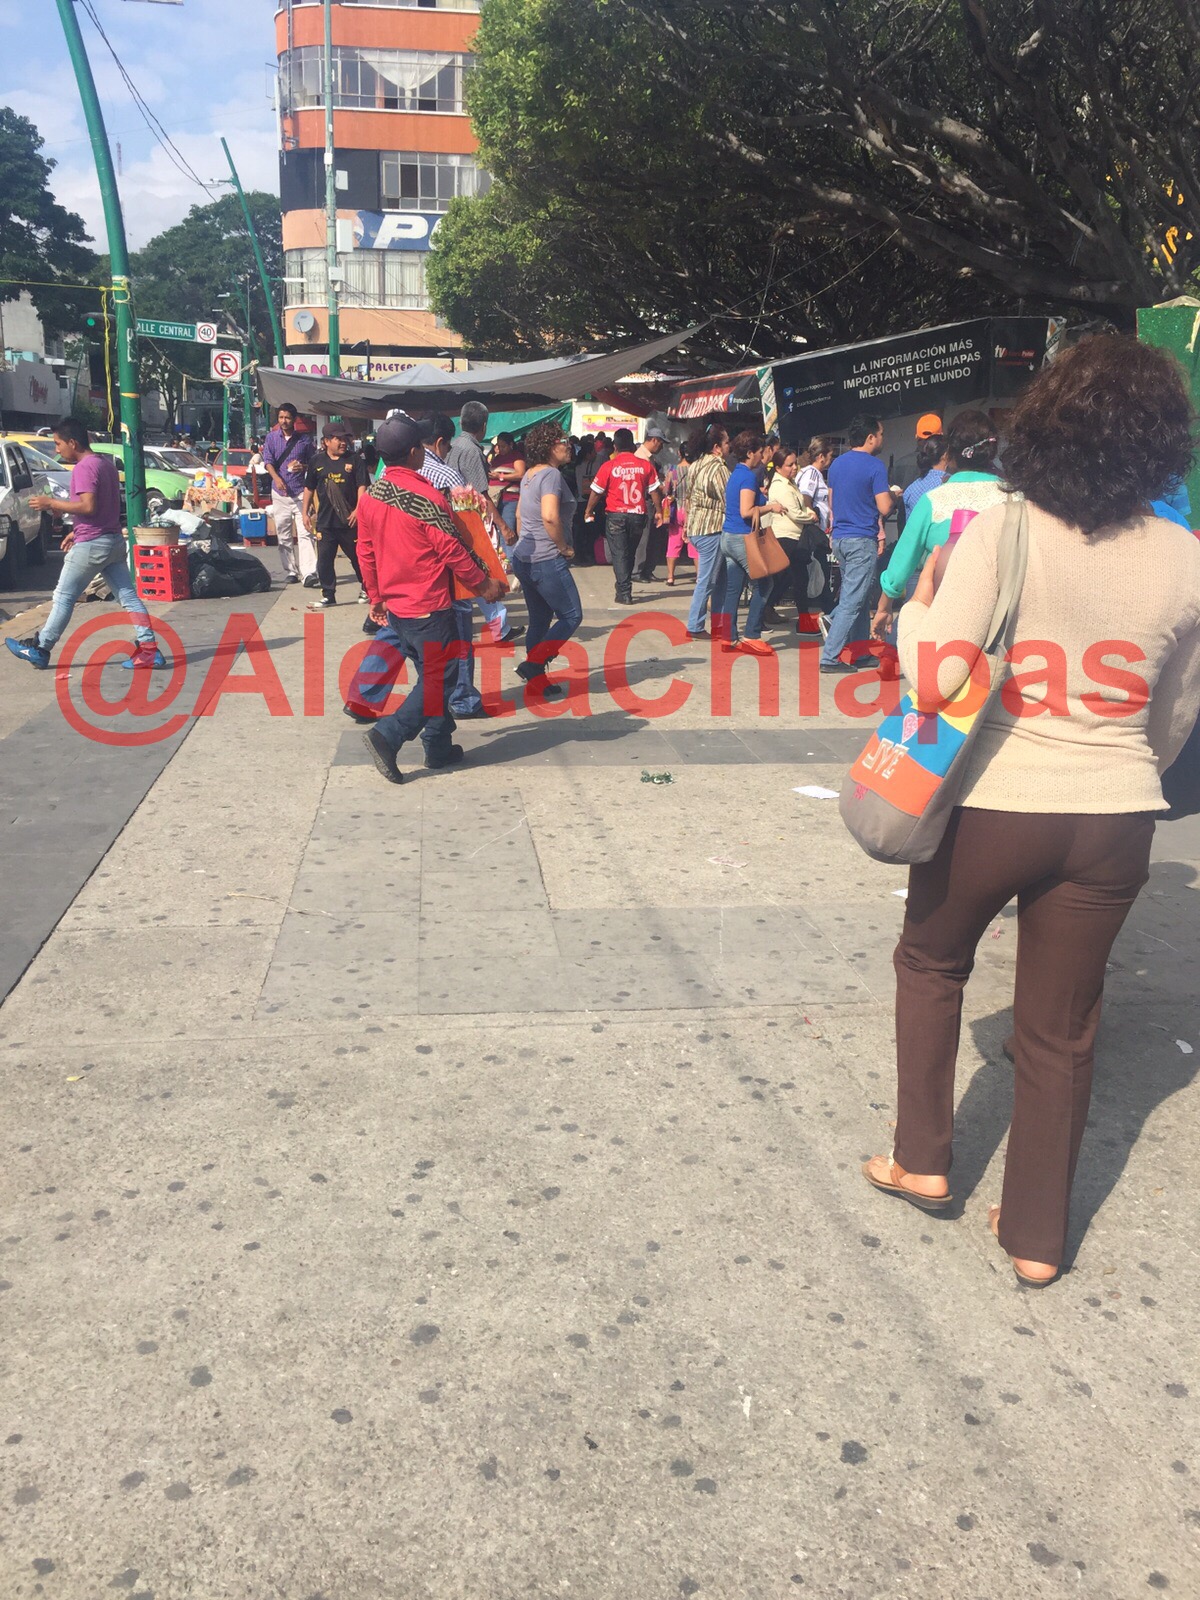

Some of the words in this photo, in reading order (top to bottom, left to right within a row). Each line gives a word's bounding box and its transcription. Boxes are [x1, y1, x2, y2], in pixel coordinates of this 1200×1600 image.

[137, 323, 156, 334] ALLE
[159, 326, 193, 338] CENTRAL
[201, 327, 212, 337] 40
[853, 362, 868, 374] LA
[870, 344, 946, 370] INFORMACIÓN
[949, 339, 973, 352] MÁS
[369, 363, 417, 373] PALETER
[843, 365, 913, 389] IMPORTANTE
[916, 363, 931, 374] DE
[934, 351, 981, 369] CHIAPAS
[859, 382, 901, 399] MÉXICO
[903, 380, 911, 389] Y
[914, 376, 928, 387] EL
[930, 367, 971, 384] MUNDO
[611, 465, 645, 478] Corona
[618, 481, 642, 505] 16
